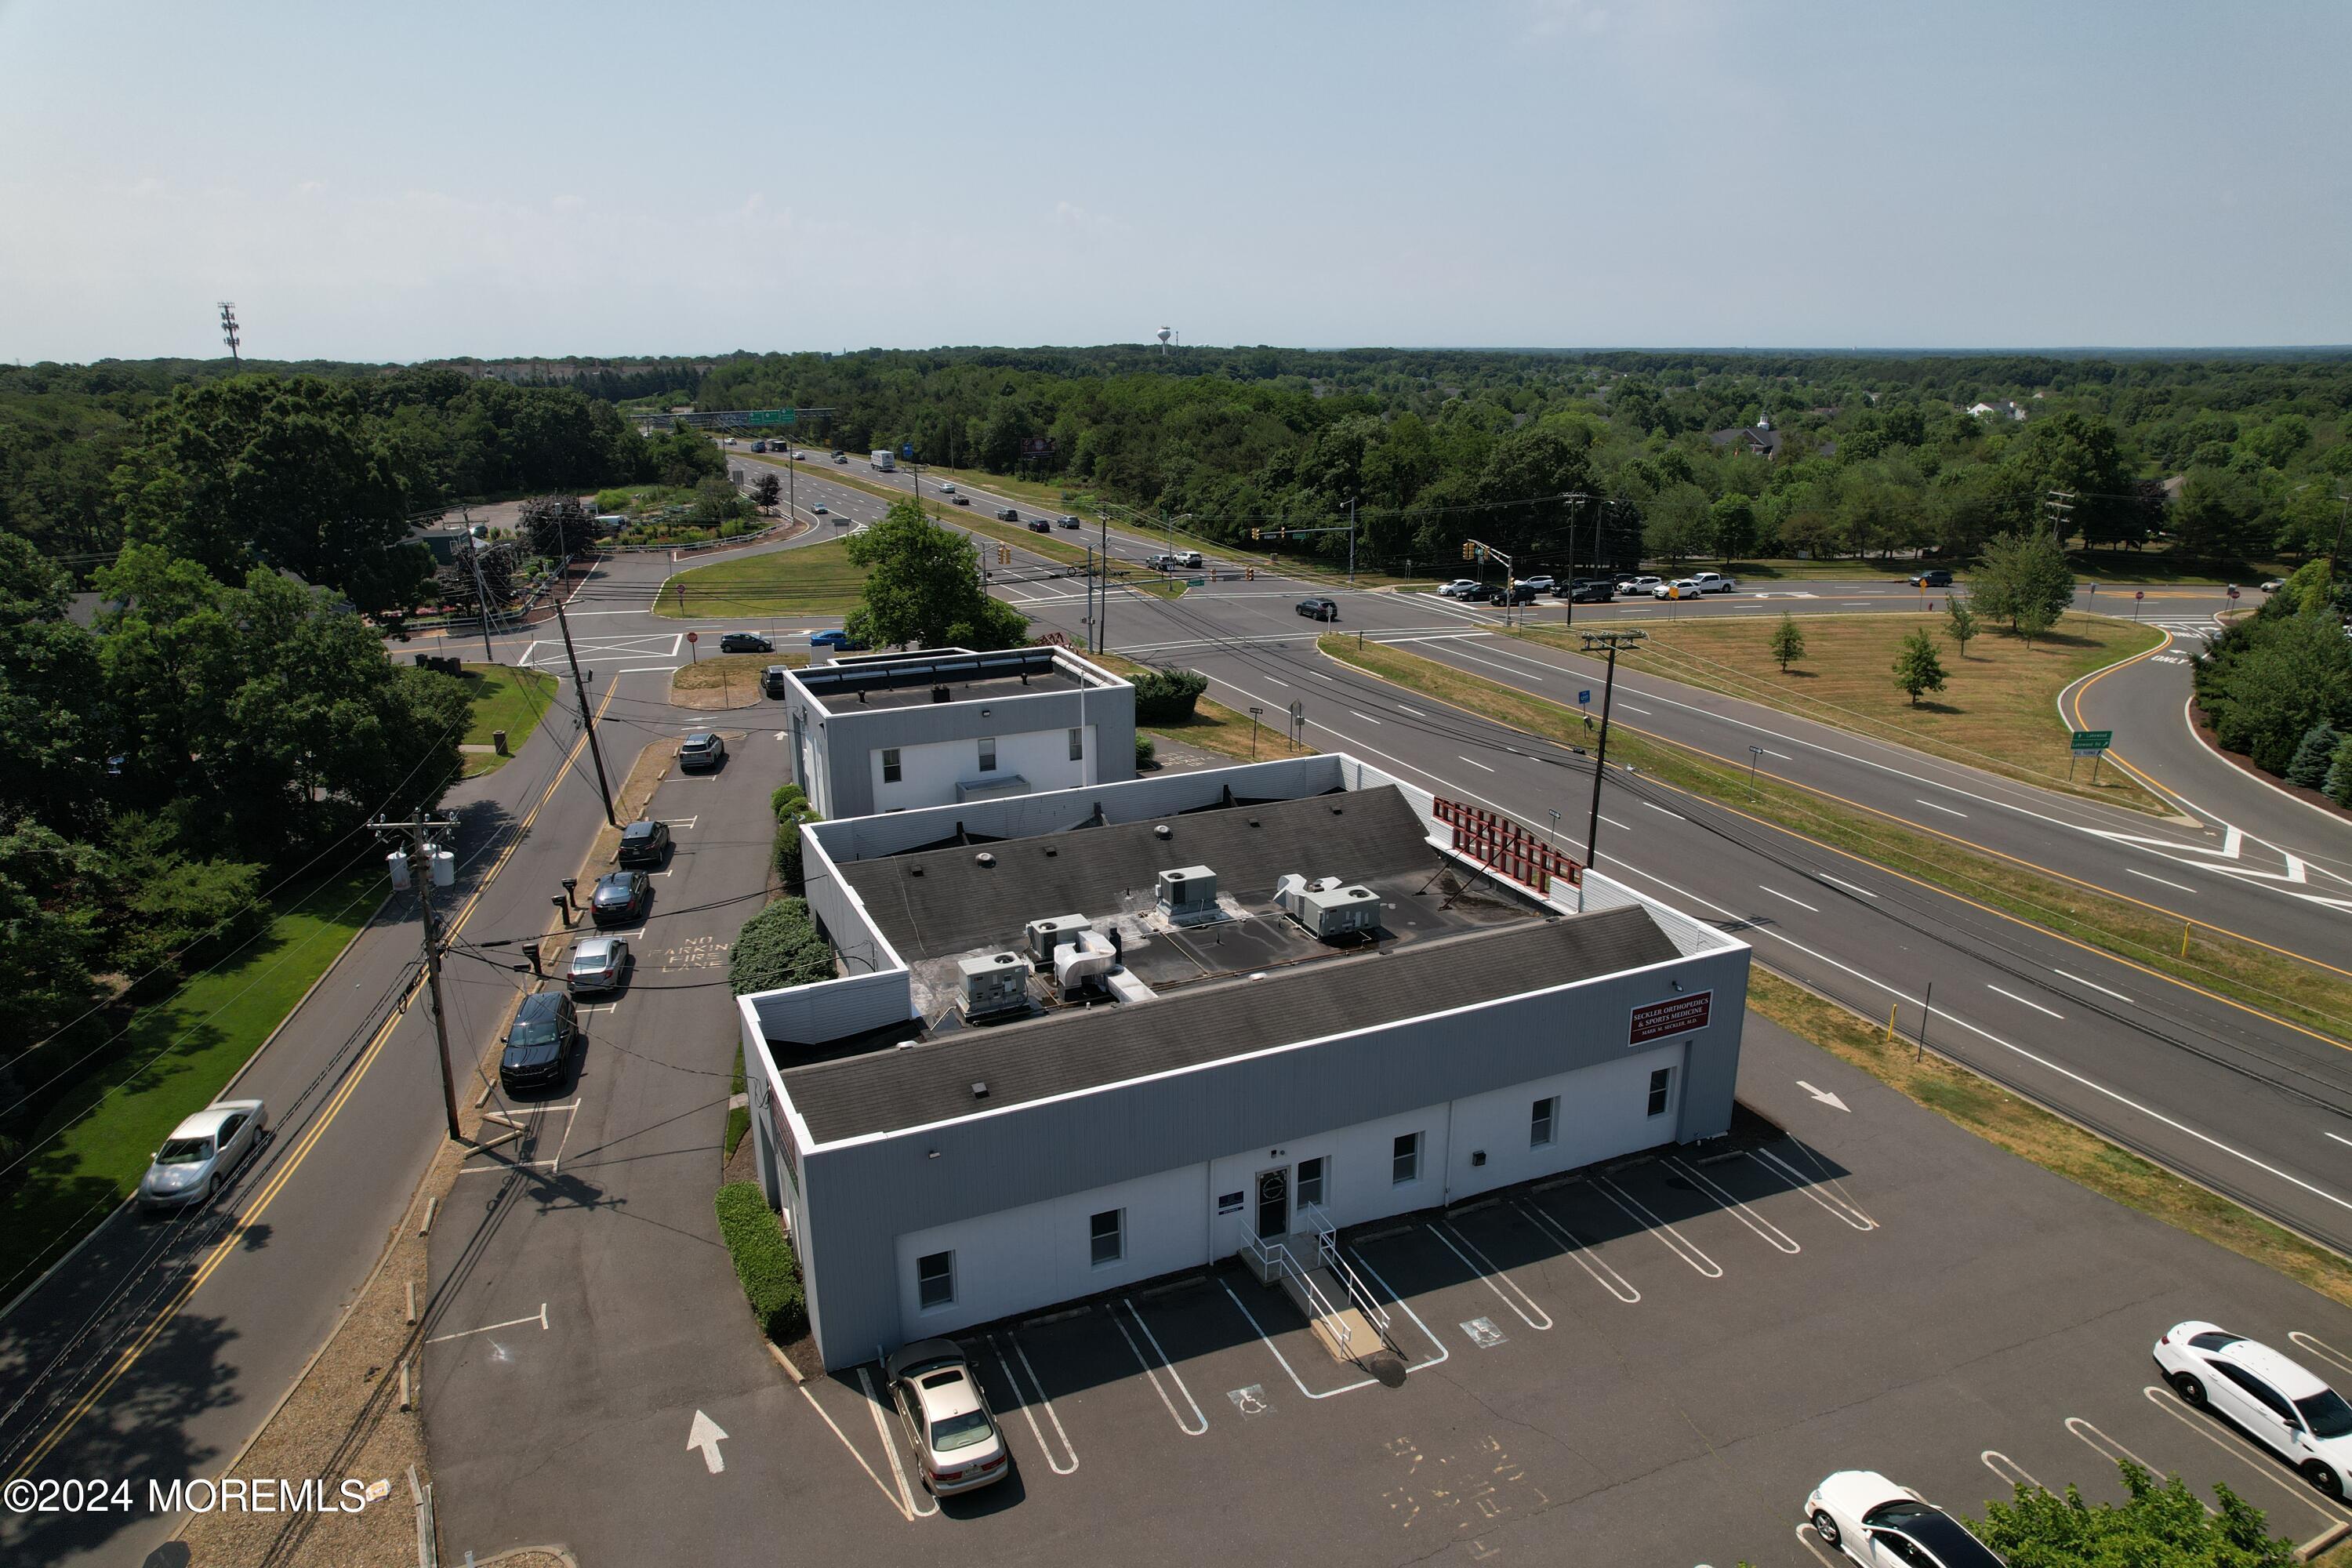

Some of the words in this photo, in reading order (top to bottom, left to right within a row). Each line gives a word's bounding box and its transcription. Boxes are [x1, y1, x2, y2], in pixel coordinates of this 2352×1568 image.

[2151, 655, 2189, 665] ONLY
[684, 936, 713, 946] NO
[648, 942, 736, 958] PARKIN
[669, 952, 720, 964] FIRE
[662, 960, 723, 973] LANE
[1634, 1009, 1662, 1021] SECKLER
[1664, 997, 1709, 1014] ORTHOPEDICS
[1645, 1015, 1670, 1026] SPORTS
[1671, 1006, 1703, 1019] MEDICINE
